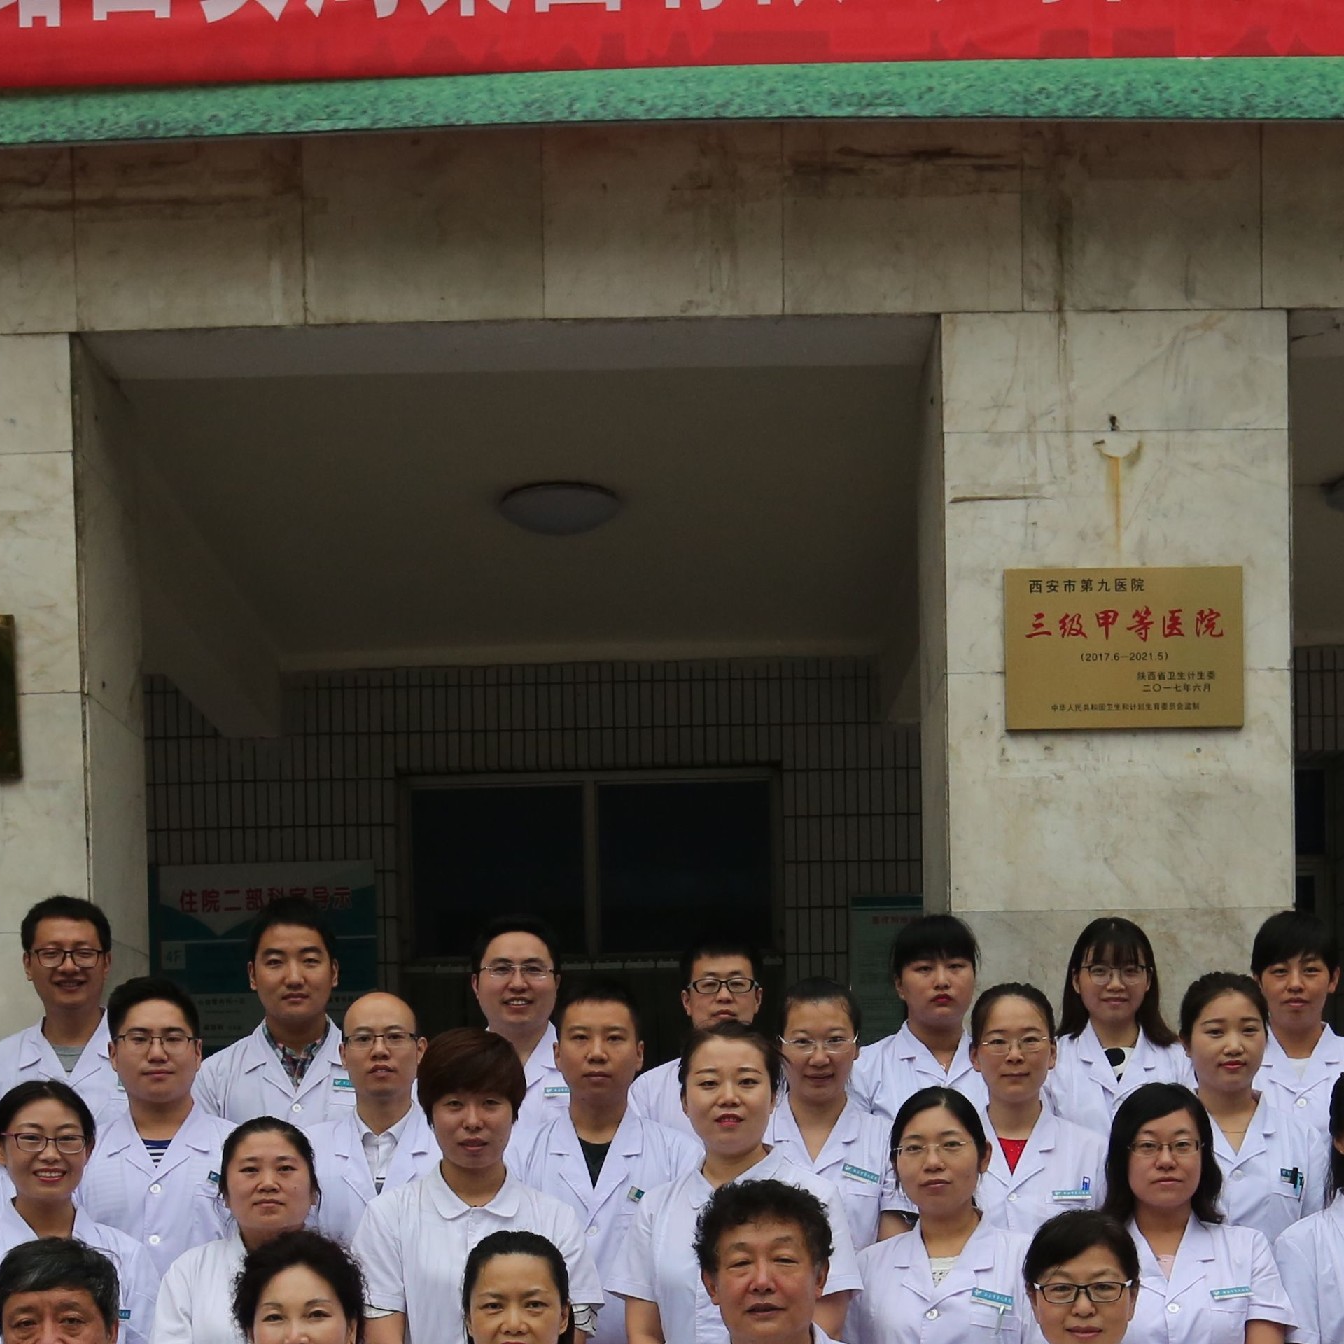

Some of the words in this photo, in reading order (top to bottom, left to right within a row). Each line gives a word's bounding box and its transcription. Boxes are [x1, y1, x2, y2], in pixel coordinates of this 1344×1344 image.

[1028, 578, 1145, 594] 西安市第九医院
[1024, 605, 1225, 642] 三级甲等医院
